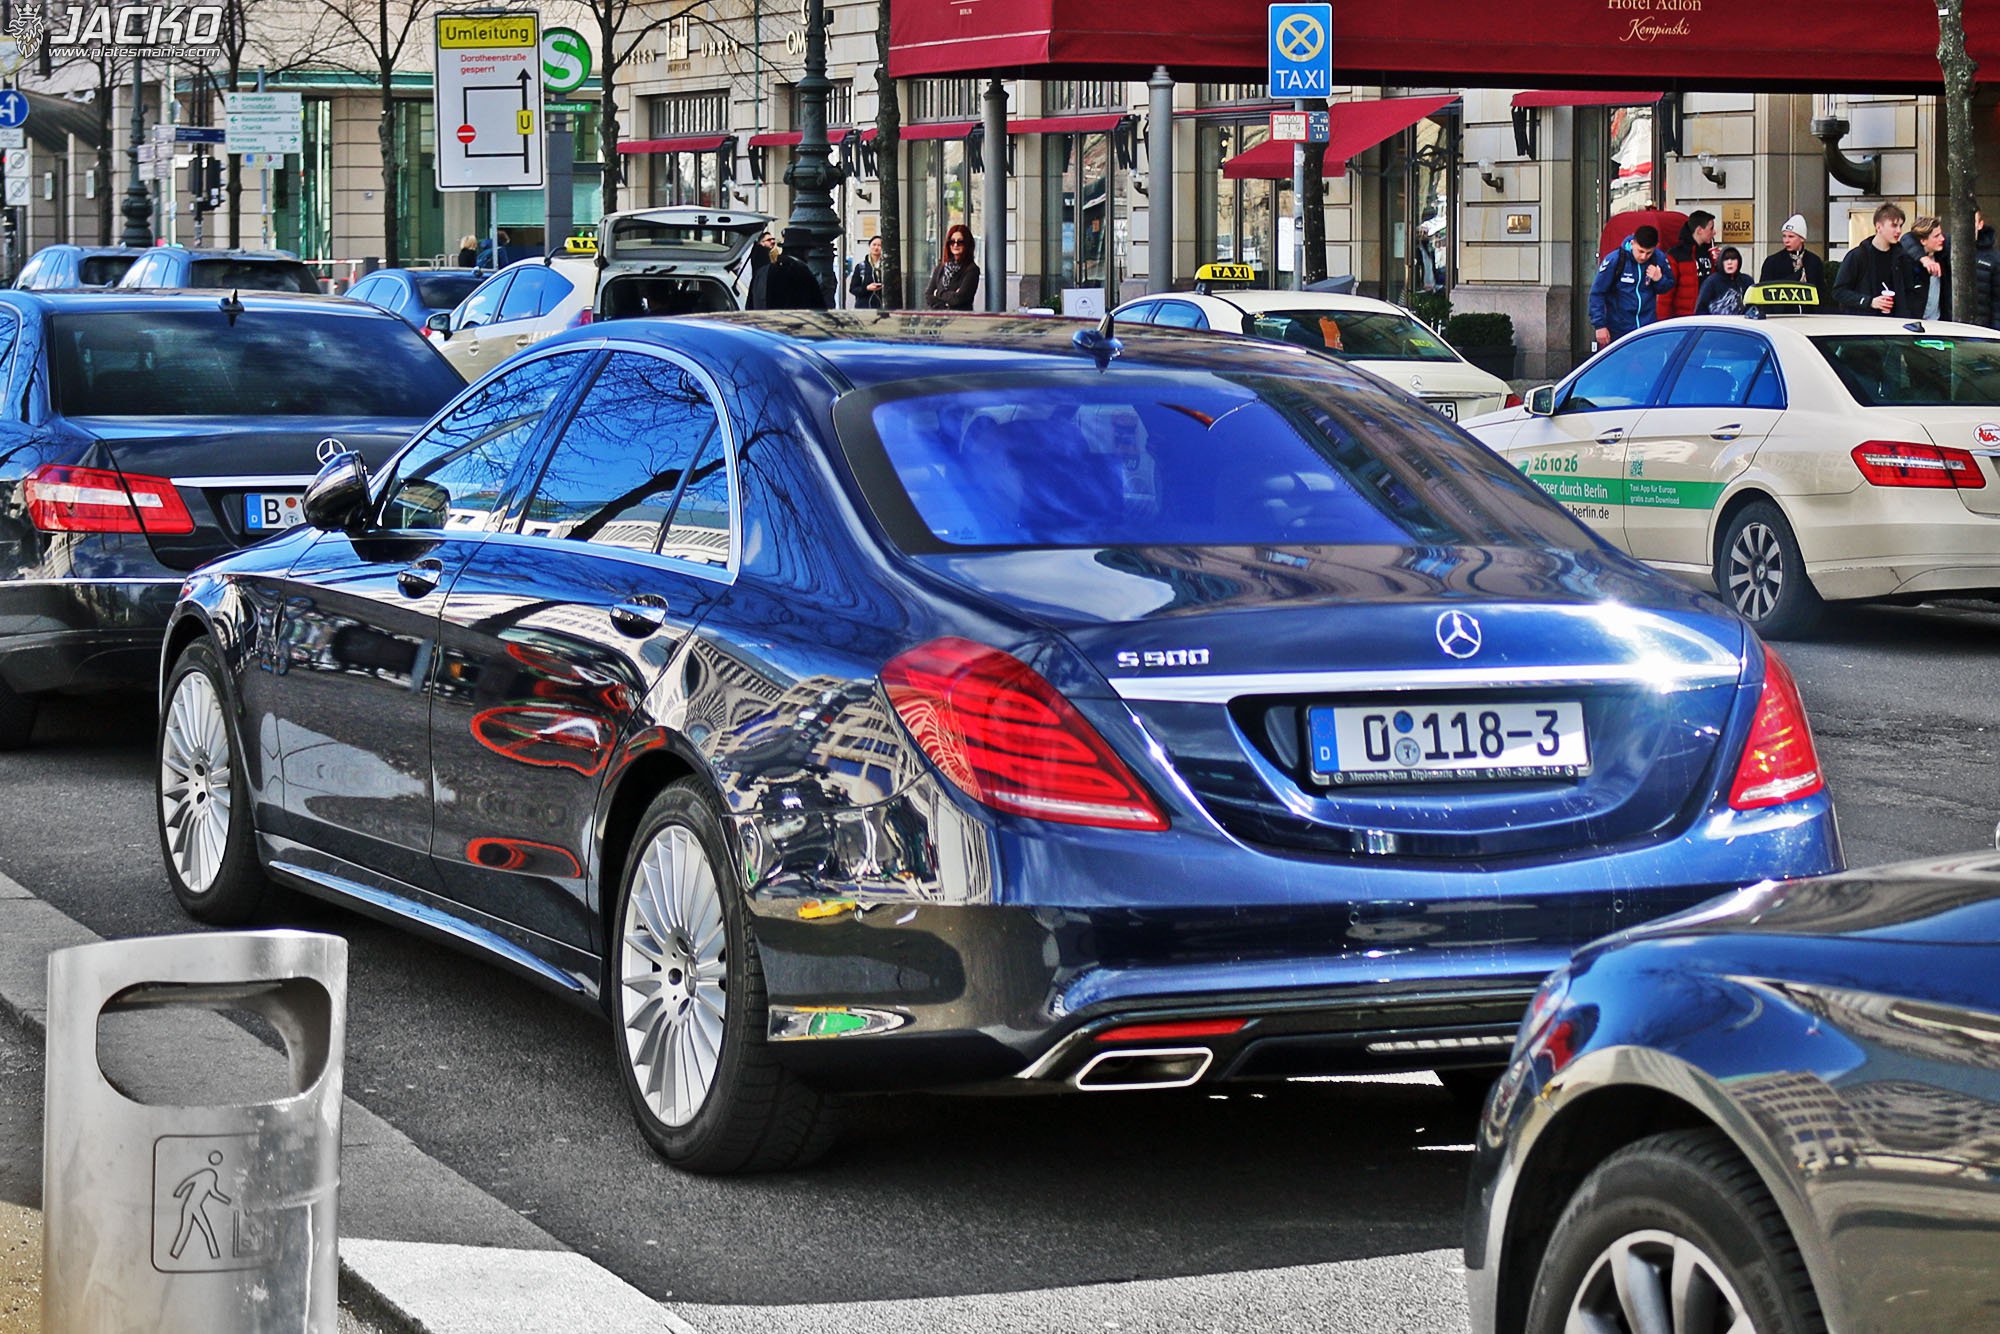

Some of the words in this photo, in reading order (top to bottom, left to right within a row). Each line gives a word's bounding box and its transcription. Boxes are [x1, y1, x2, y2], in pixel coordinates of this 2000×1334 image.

[446, 27, 529, 42] Umleitung
[1619, 15, 1691, 42] Kempinski
[701, 39, 740, 58] UHREN
[460, 53, 527, 62] Dorotheenstraße
[460, 65, 496, 75] gesperrt
[1275, 70, 1325, 89] TAXI
[520, 115, 530, 129] U
[1722, 221, 1751, 231] KRIGLER
[576, 240, 597, 249] TA
[1212, 266, 1248, 278] TAXI
[1768, 288, 1807, 301] TAXI
[1534, 453, 1548, 471] 26
[1550, 458, 1562, 472] 10
[1564, 454, 1578, 473] 26
[1560, 481, 1582, 494] durch
[1584, 482, 1608, 499] Berlin
[1640, 485, 1650, 493] App
[1658, 485, 1676, 495] Europa
[1655, 495, 1680, 504] Download
[264, 498, 281, 524] B
[1117, 652, 1140, 667] S
[1422, 709, 1560, 761] 118-3
[1320, 746, 1331, 761] D
